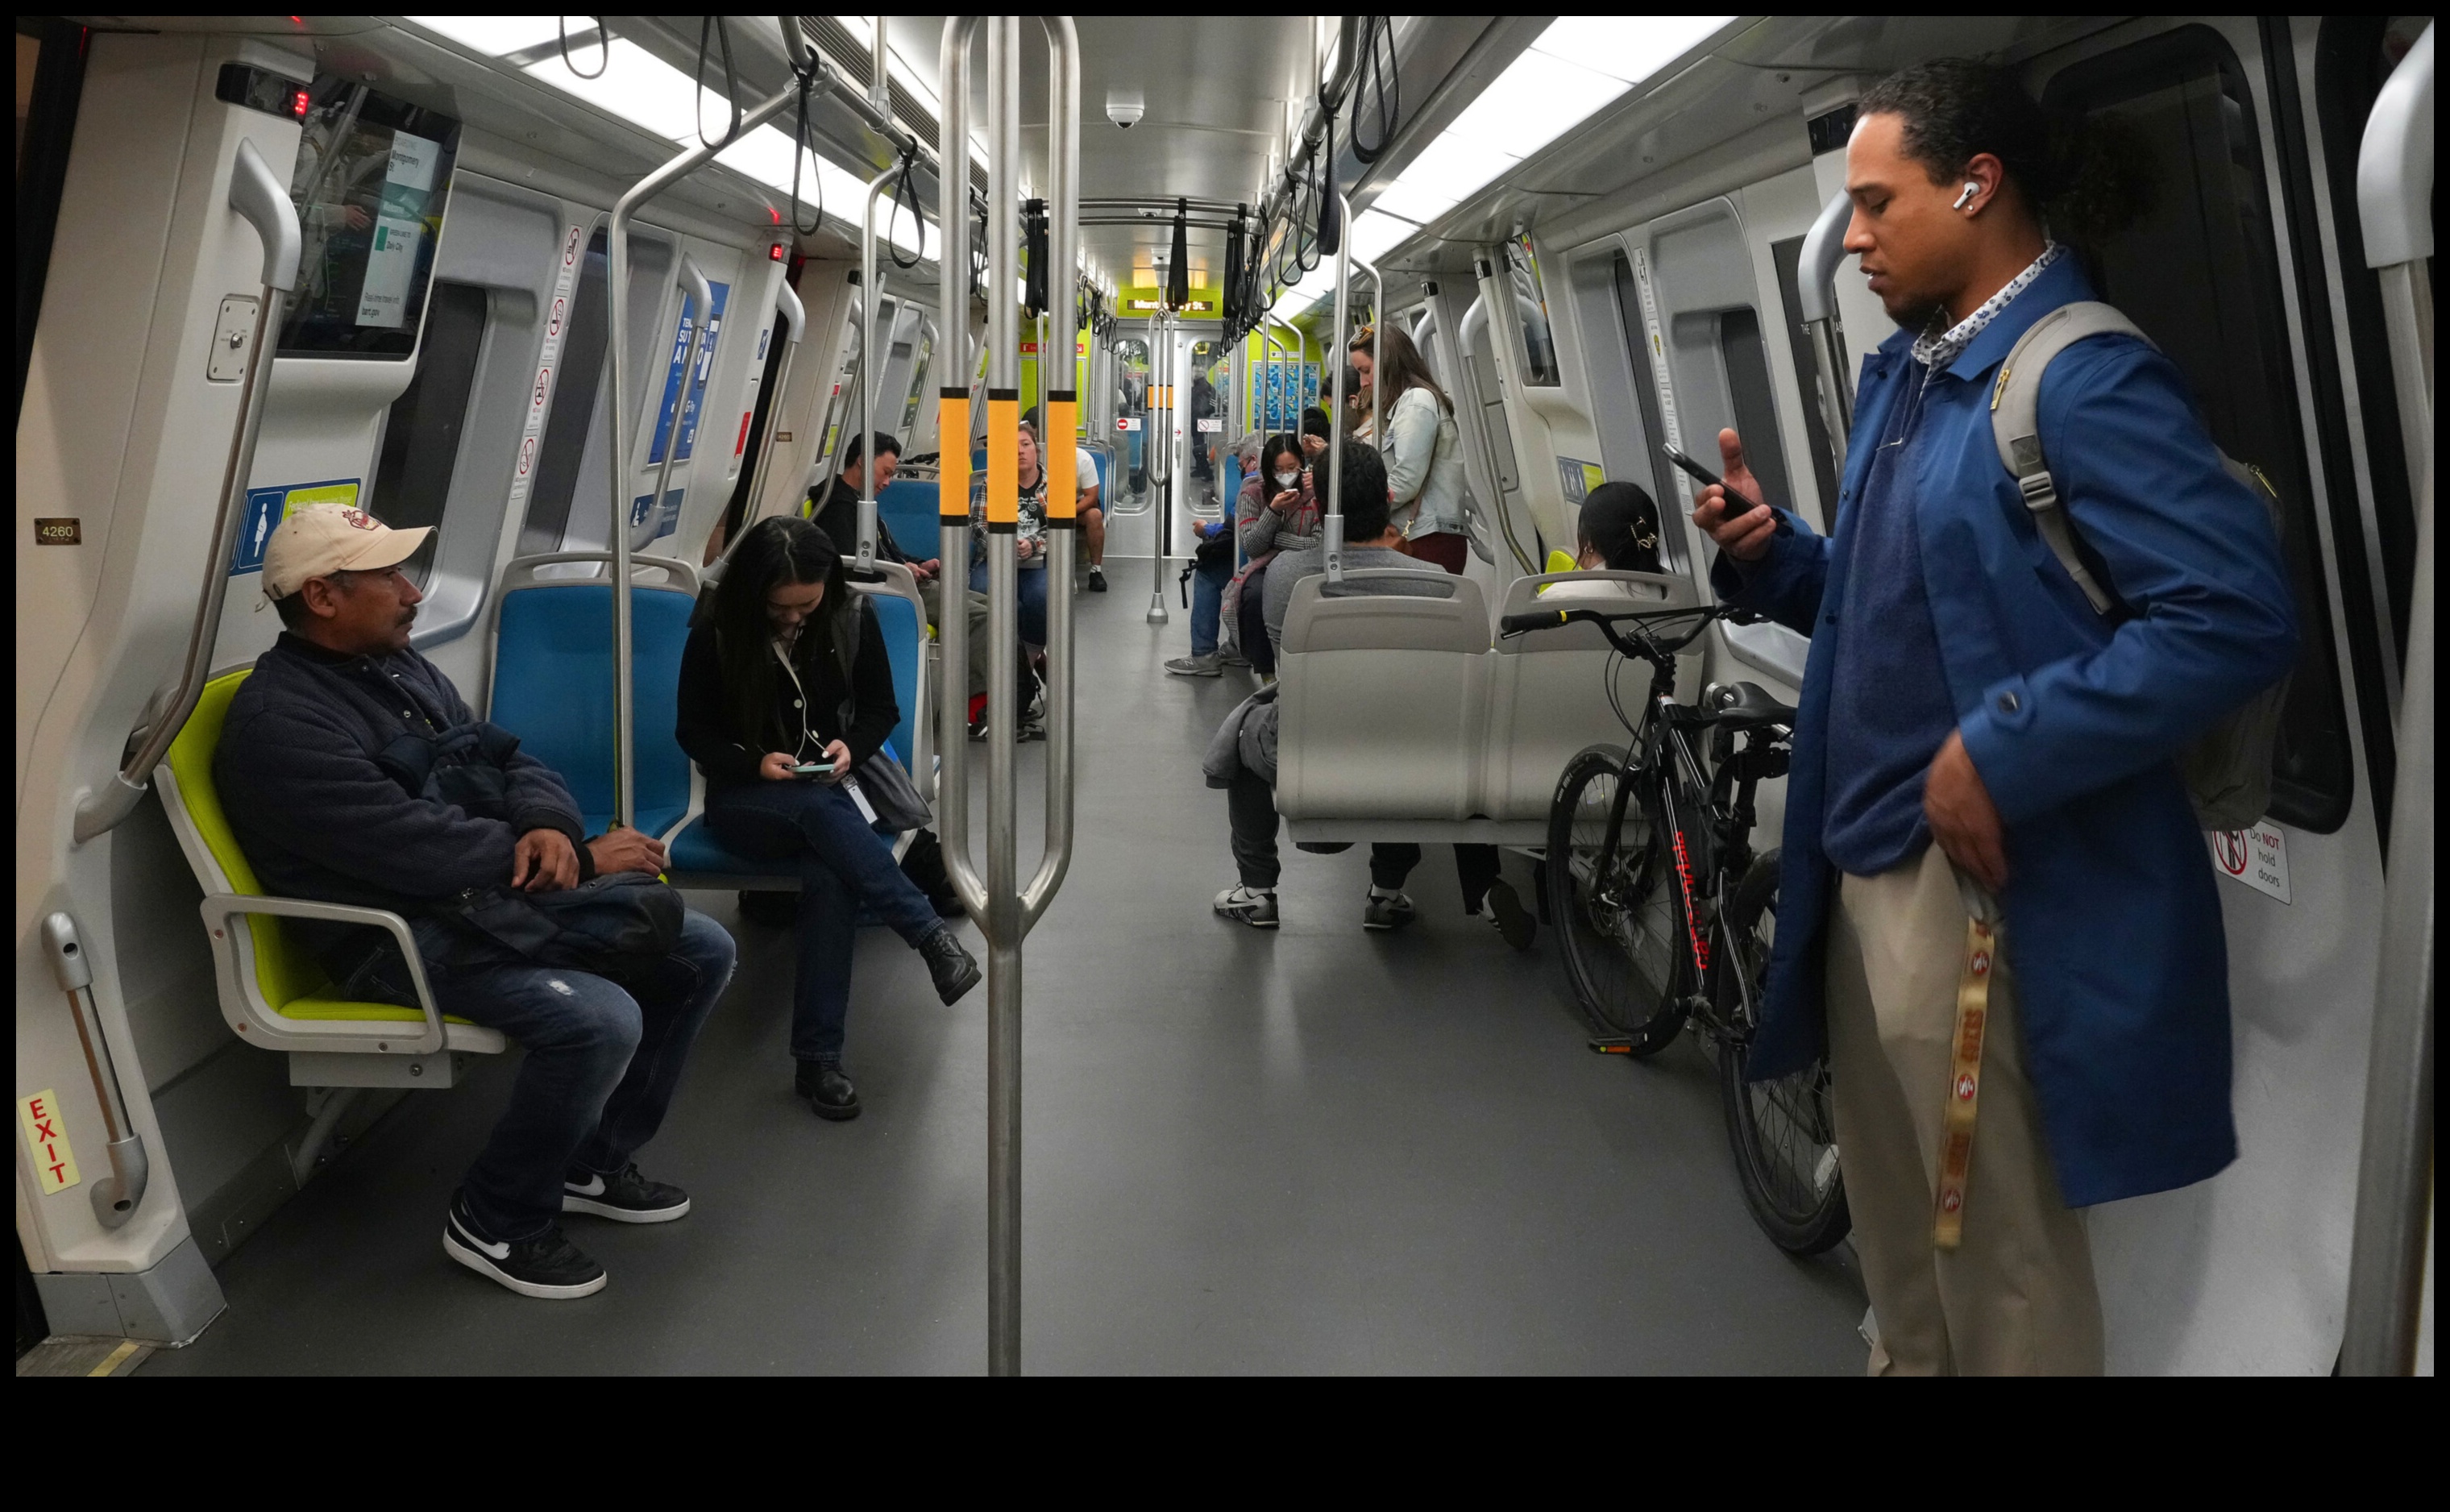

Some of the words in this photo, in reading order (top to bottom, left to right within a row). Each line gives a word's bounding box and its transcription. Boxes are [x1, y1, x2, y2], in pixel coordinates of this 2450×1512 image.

[391, 149, 419, 168] Montgomery
[361, 307, 380, 318] bart.gov
[42, 525, 73, 538] 4260
[2250, 828, 2261, 842] Do
[2262, 833, 2279, 850] NOT
[2257, 848, 2276, 866] hold
[2258, 867, 2280, 887] doors
[1672, 831, 1709, 970] candale
[30, 1098, 65, 1184] EXIT
